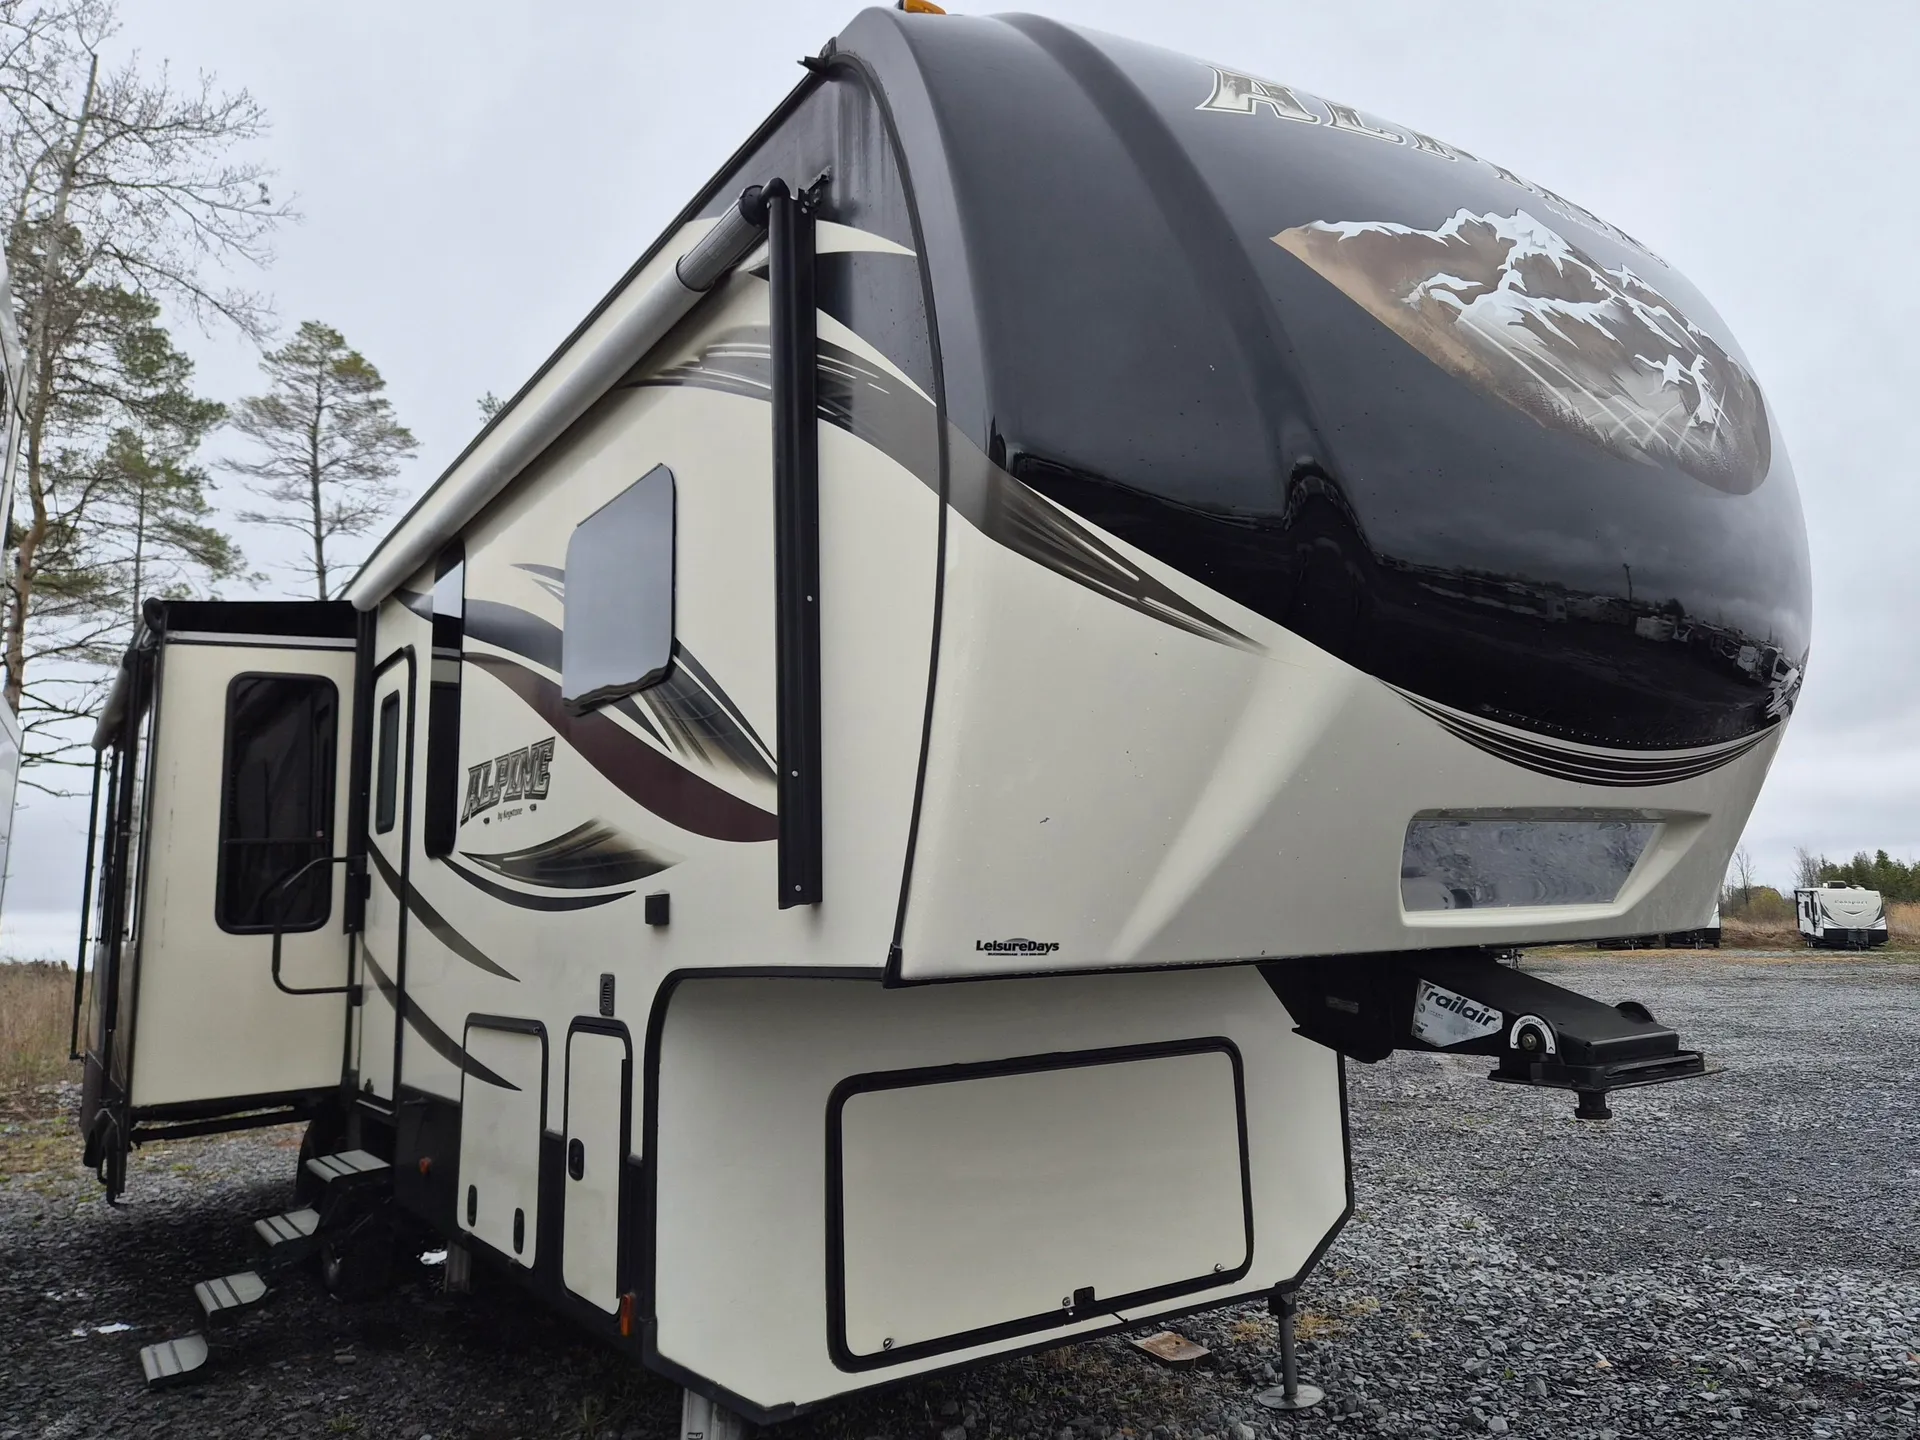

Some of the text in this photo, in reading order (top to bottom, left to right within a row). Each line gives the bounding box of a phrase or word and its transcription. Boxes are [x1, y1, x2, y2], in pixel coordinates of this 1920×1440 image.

[460, 736, 555, 828] ALPINE
[976, 940, 1060, 953] LeisureDays
[1421, 982, 1497, 1027] Trailair
